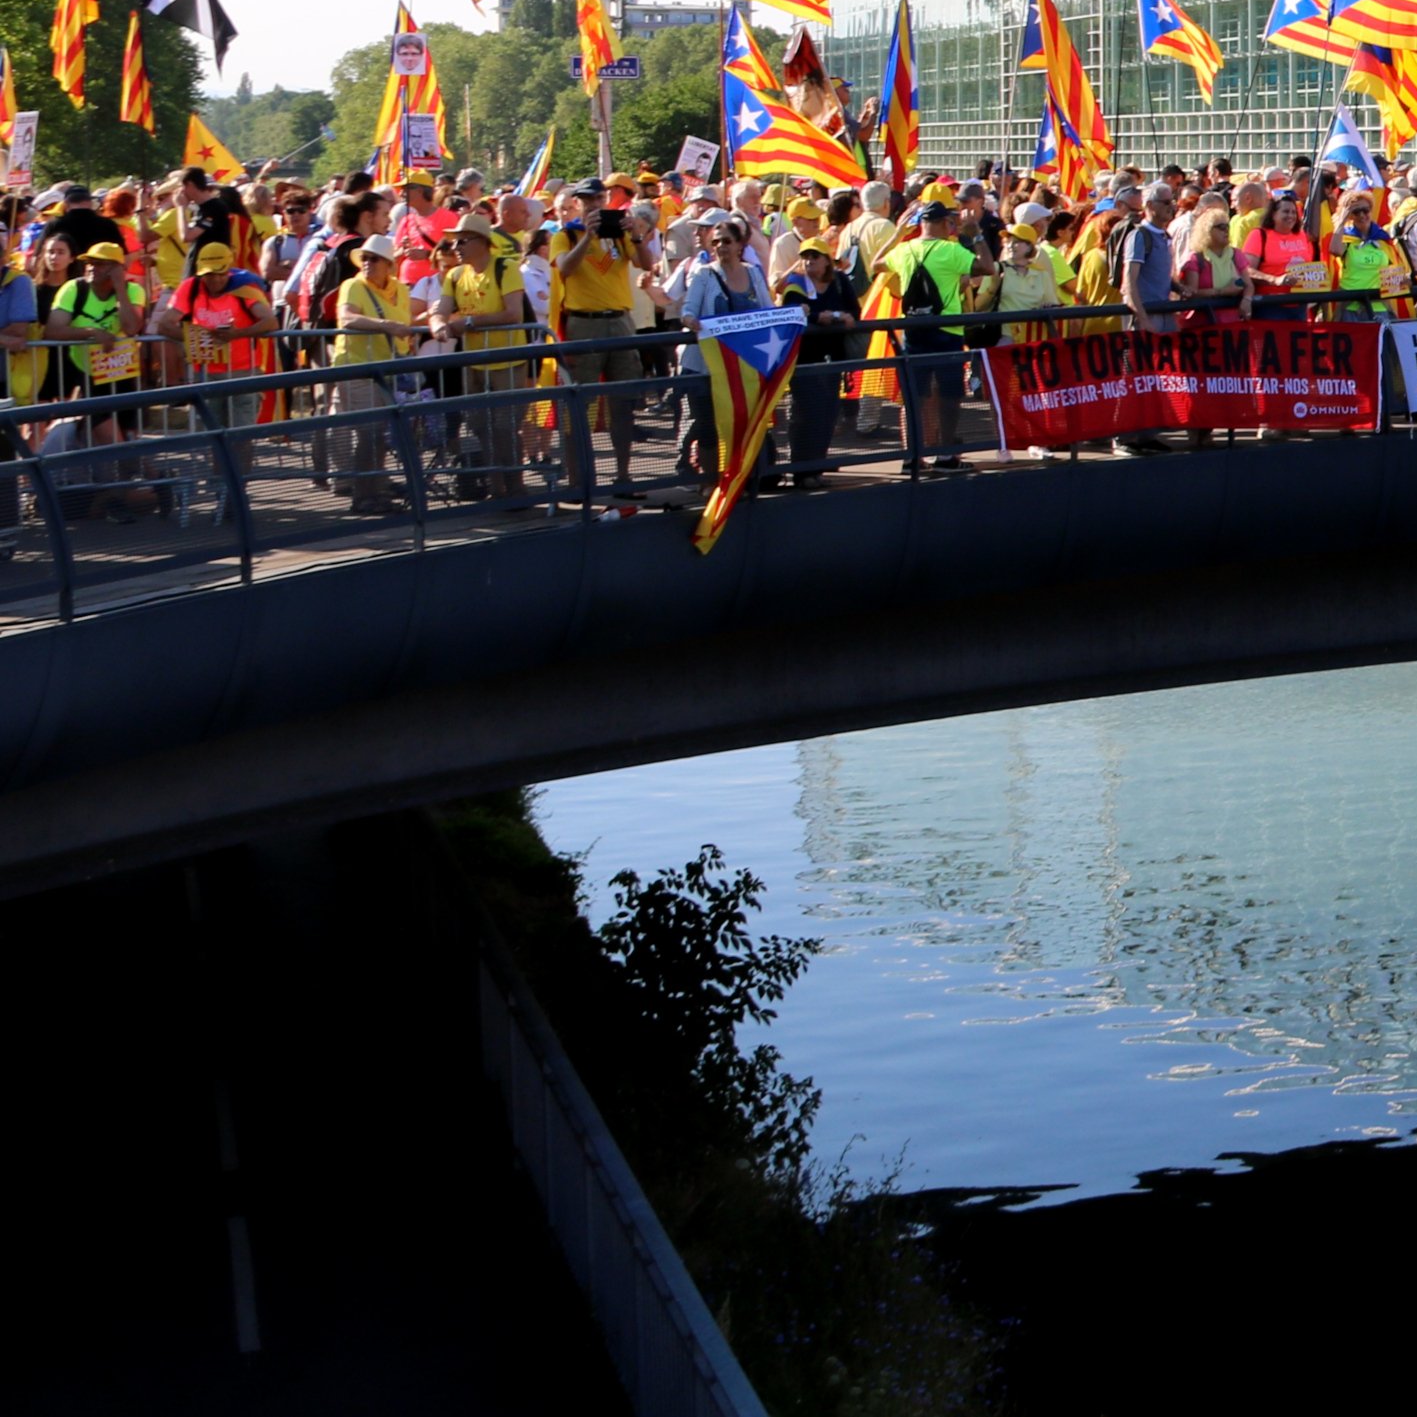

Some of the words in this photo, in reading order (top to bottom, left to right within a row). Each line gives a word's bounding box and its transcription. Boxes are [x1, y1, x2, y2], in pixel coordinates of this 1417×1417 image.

[1304, 271, 1326, 282] NOT
[1012, 341, 1060, 393] HO
[1064, 330, 1250, 383] TORNAREM
[1260, 330, 1282, 375] A
[1290, 331, 1354, 376] FER
[1022, 379, 1128, 413] MANIFESTAR-NOS
[1206, 377, 1309, 395] MOBILITZAR-NOS
[1316, 378, 1358, 396] VOTAR
